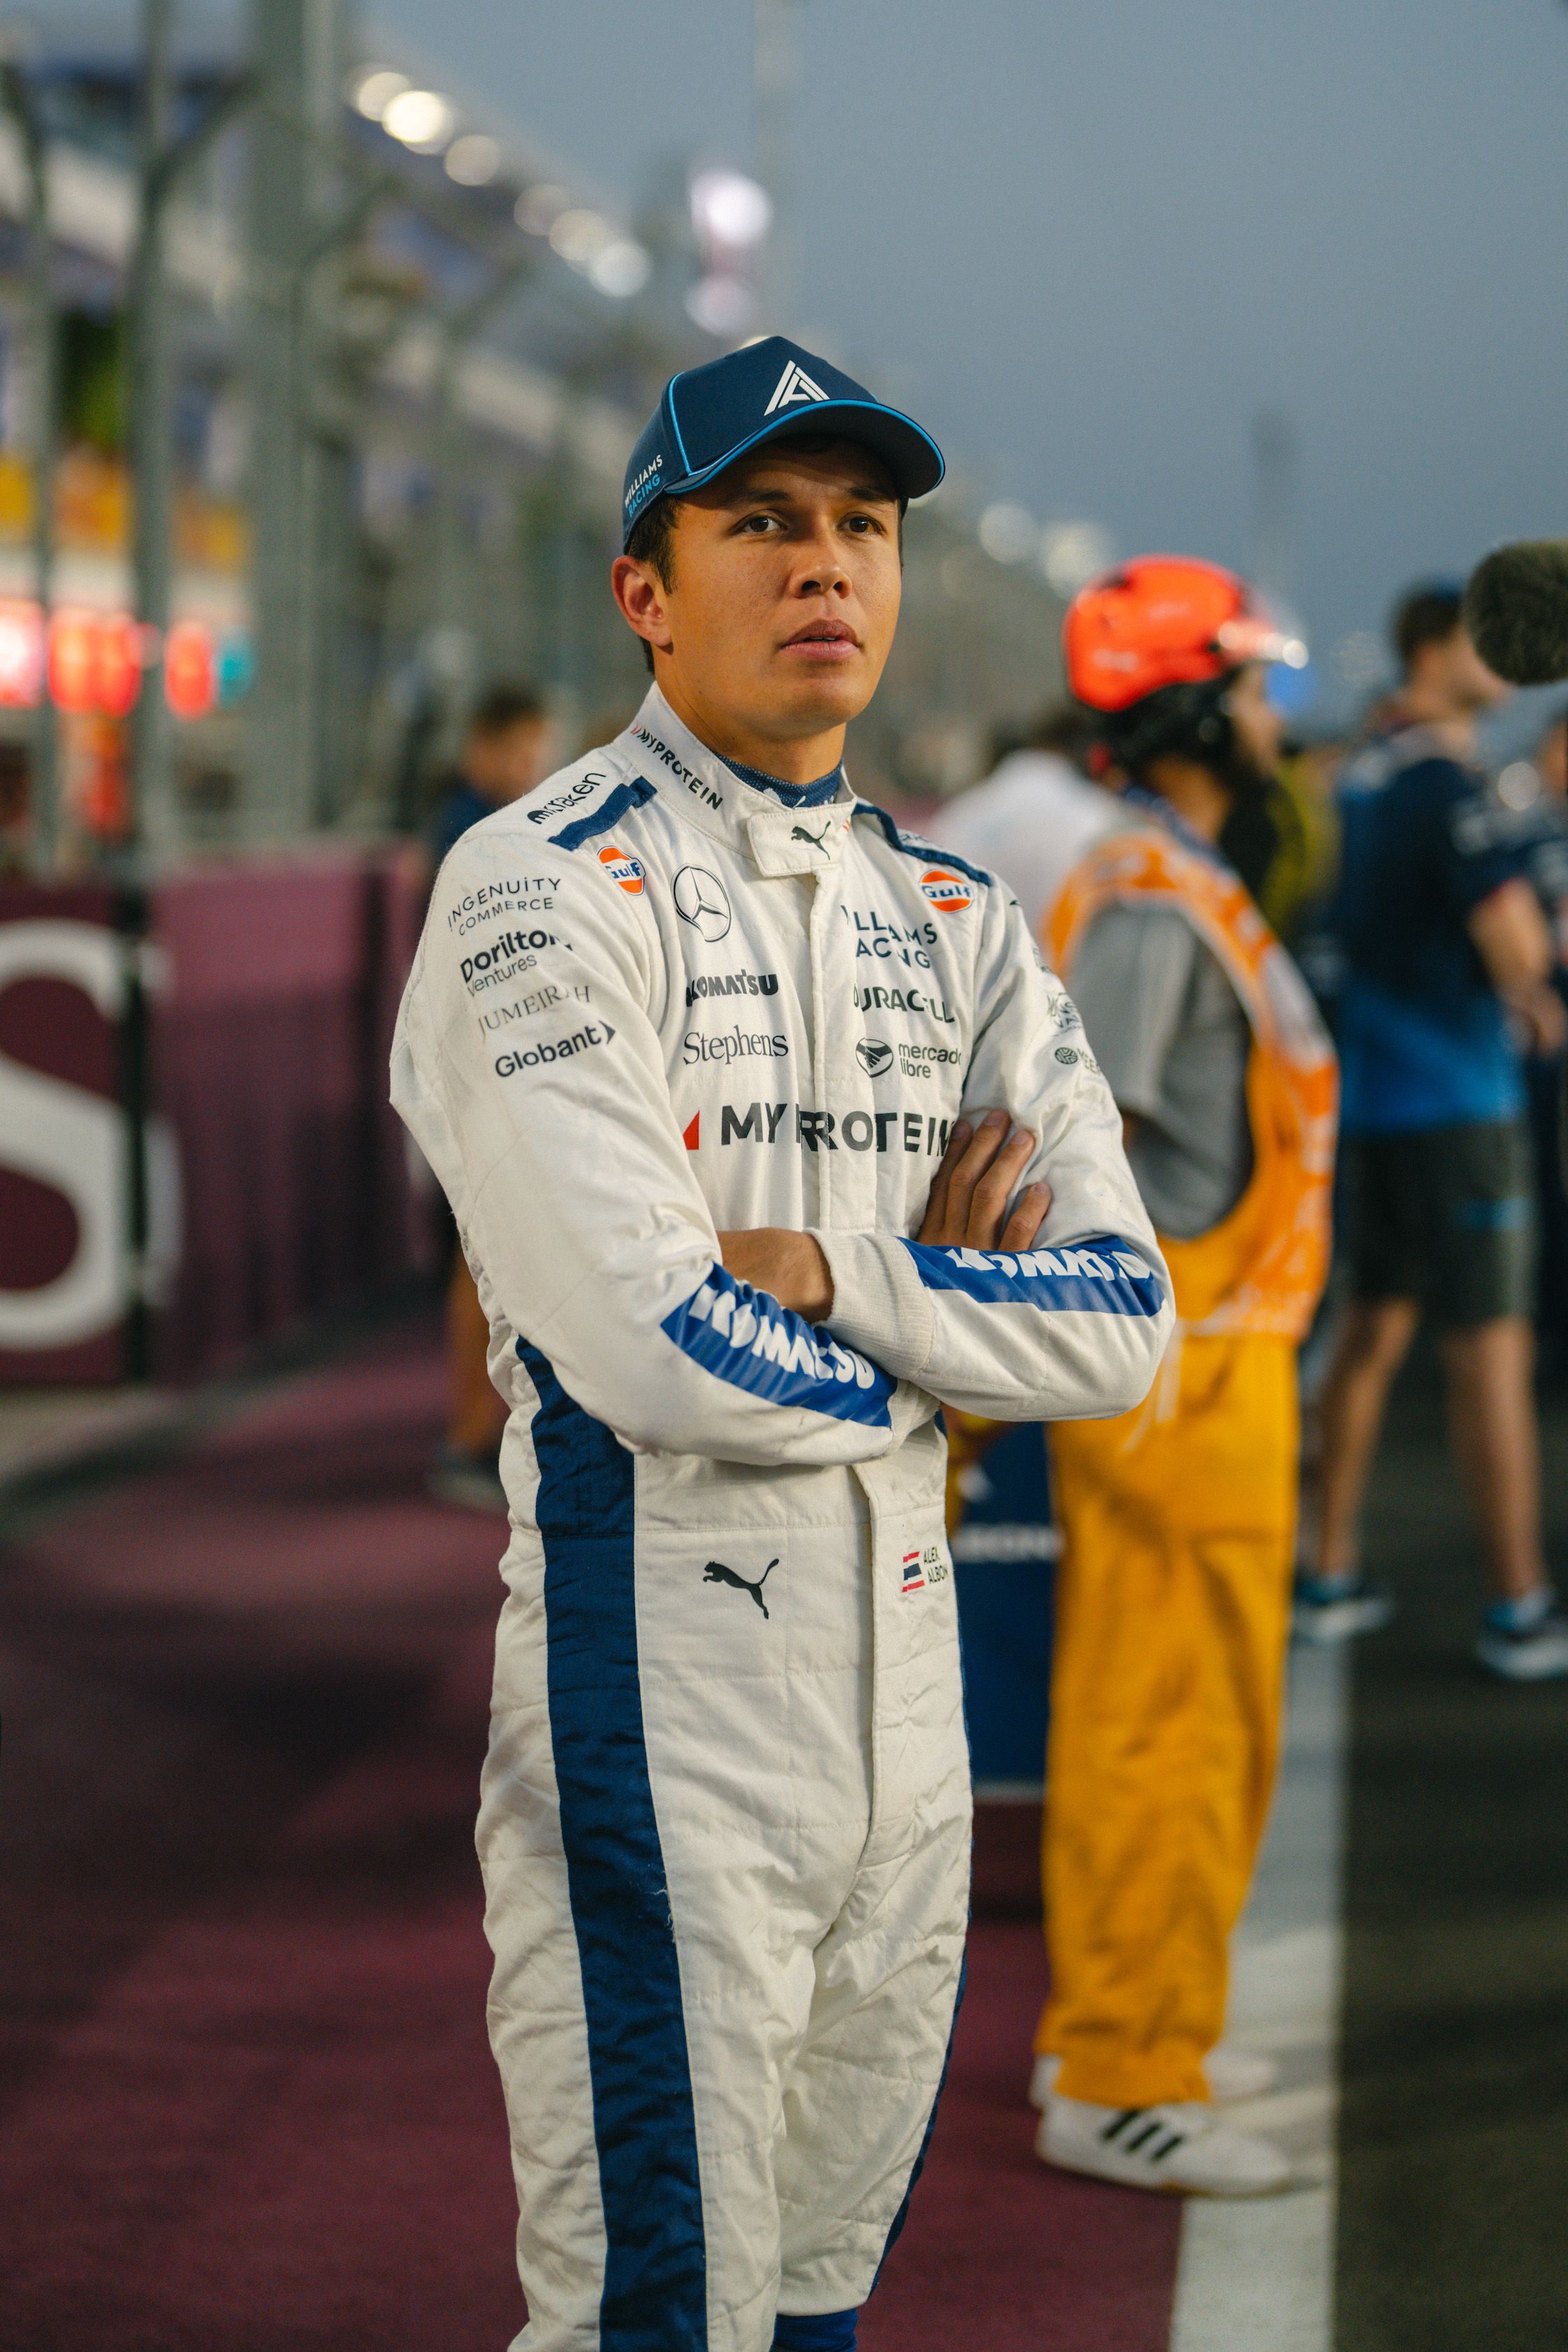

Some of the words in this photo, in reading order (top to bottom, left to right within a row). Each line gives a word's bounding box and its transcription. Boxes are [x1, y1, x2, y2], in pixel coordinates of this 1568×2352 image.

[628, 473, 661, 517] RACING
[636, 729, 724, 810] MYPROTEIN
[921, 884, 971, 898] Gulf
[459, 897, 554, 936] COMMERCE
[686, 968, 779, 1007] KOMATSU
[477, 984, 591, 1045] JUMEIRH
[495, 1026, 602, 1077] Globant
[683, 1024, 789, 1065] Stephens
[898, 1043, 961, 1066] mercad
[900, 1058, 931, 1078] libre
